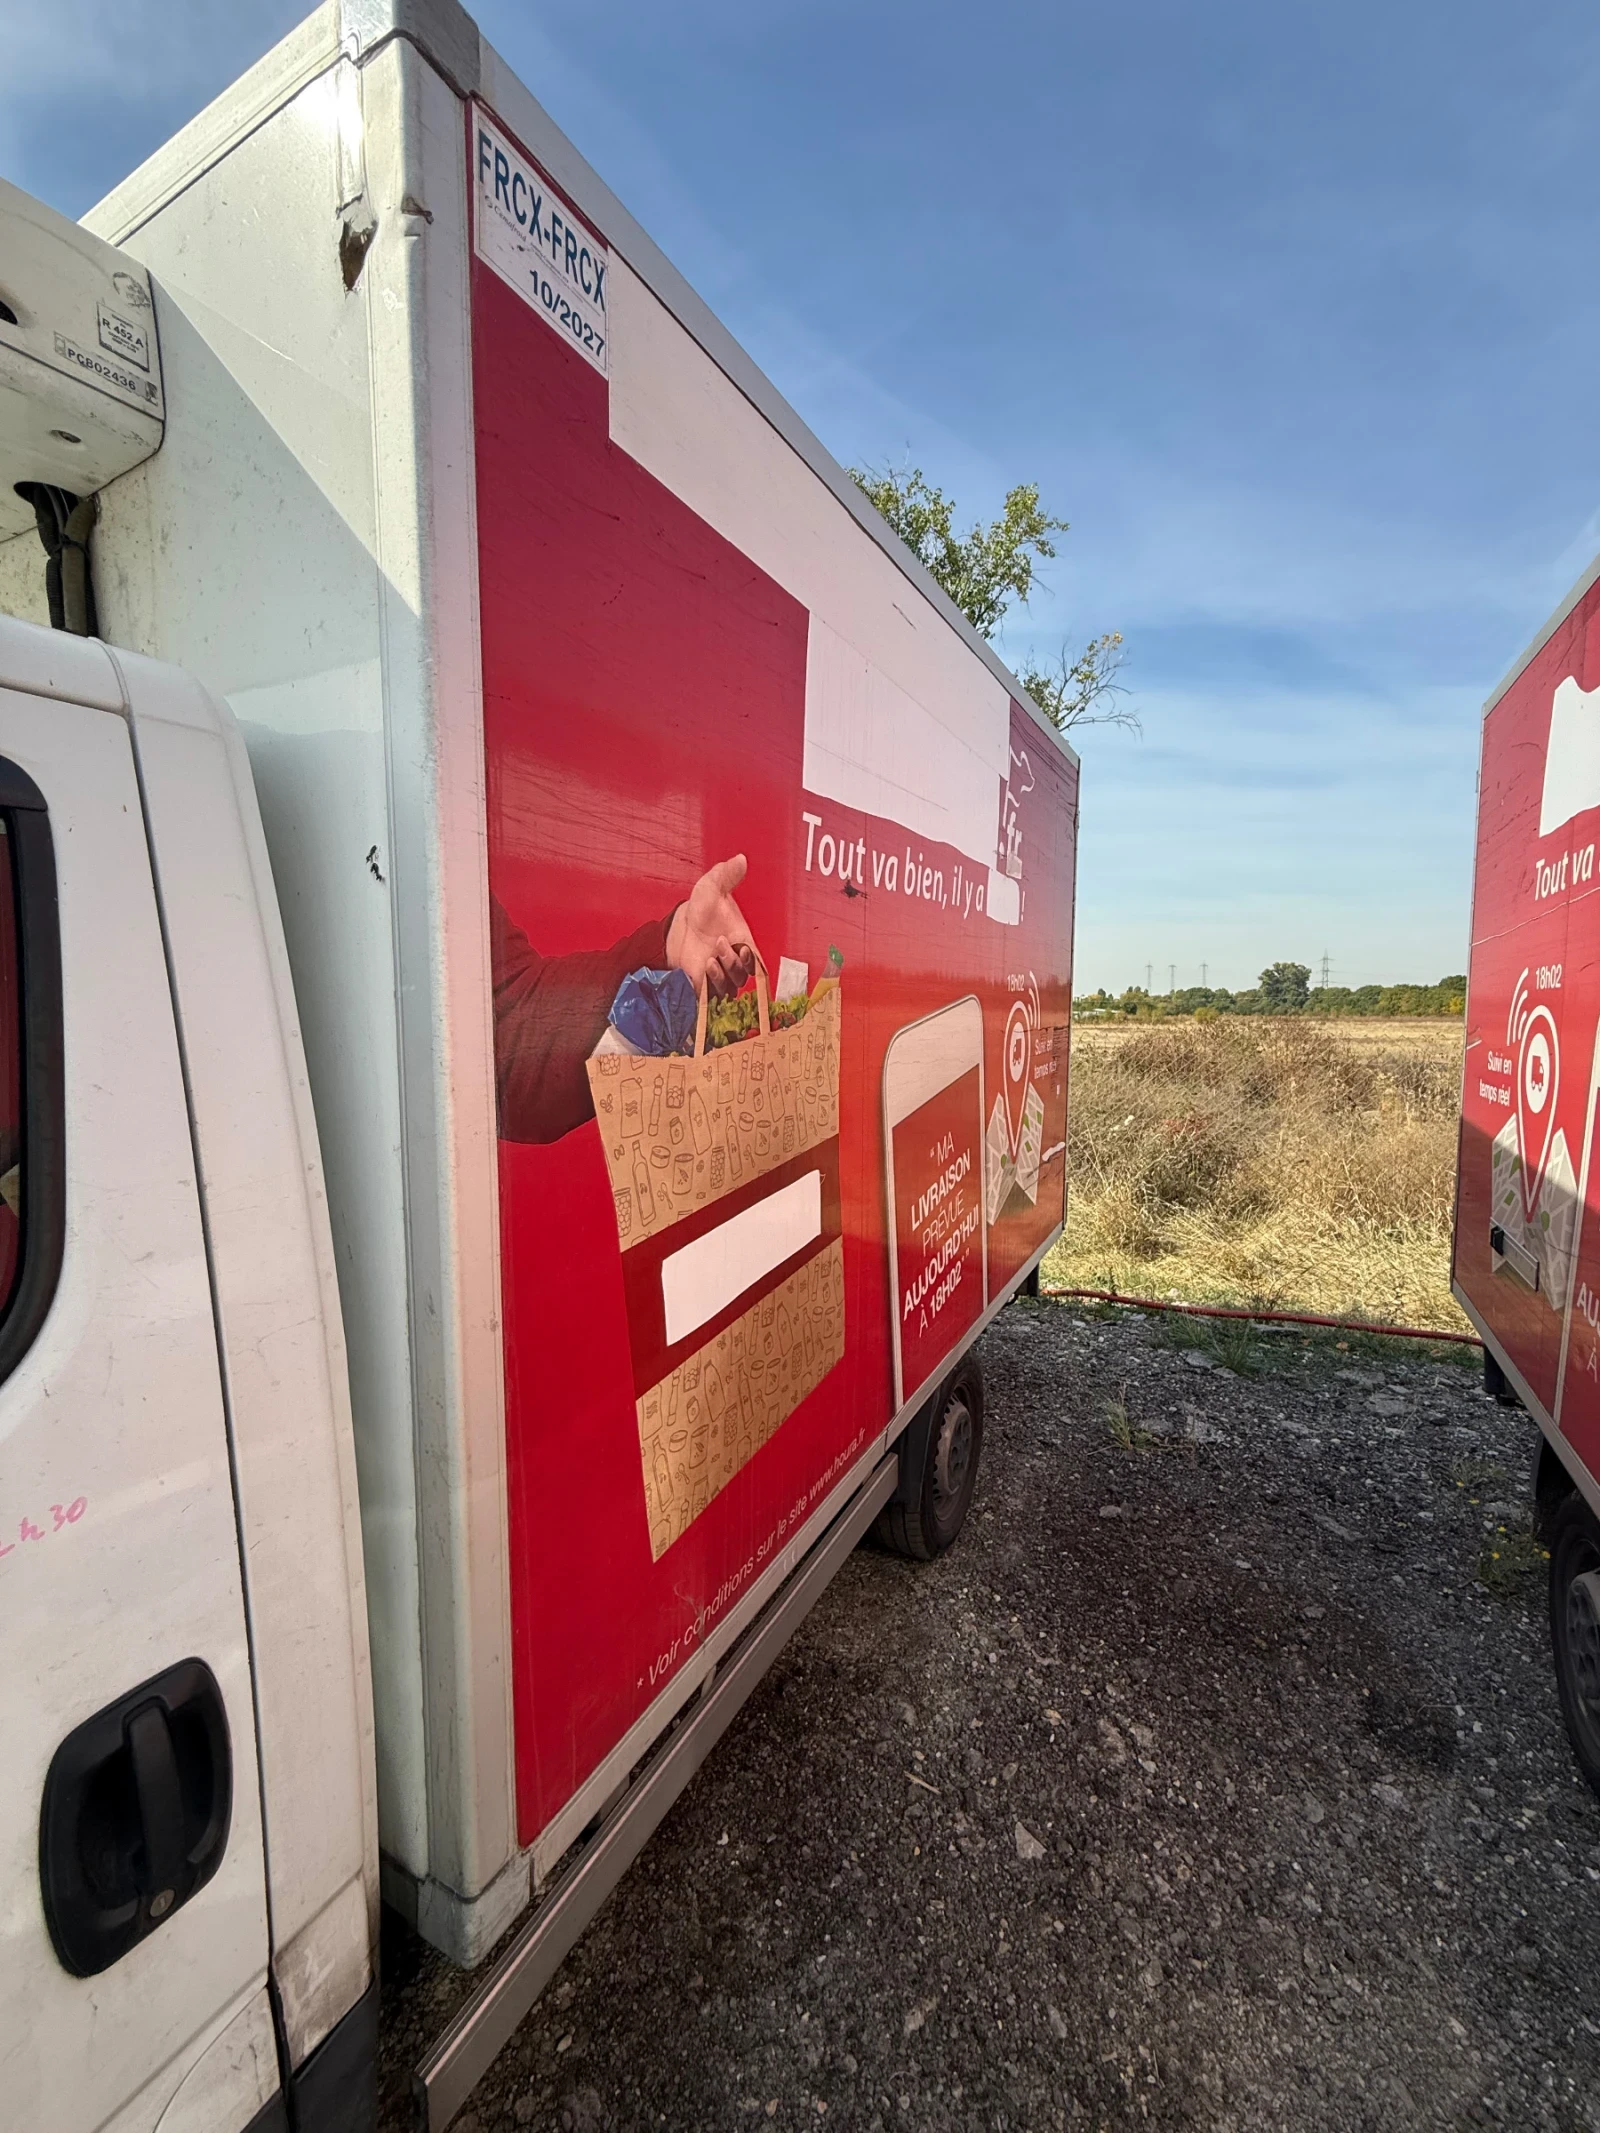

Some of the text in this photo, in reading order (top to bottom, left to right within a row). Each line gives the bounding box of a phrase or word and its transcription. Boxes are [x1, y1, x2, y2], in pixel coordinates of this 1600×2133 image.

[478, 129, 606, 313] FRCX-FRCX
[102, 317, 111, 330] R
[114, 326, 133, 342] 452
[136, 337, 144, 348] A
[530, 269, 606, 357] 10/2027
[67, 348, 136, 391] PCB02436
[802, 811, 985, 920] Tout va bien, il y a
[1535, 844, 1595, 901] Tout va
[1536, 963, 1562, 990] 18h02
[1488, 1050, 1512, 1075] Suivi en
[1479, 1079, 1497, 1104] temps
[937, 1131, 955, 1167] MA
[911, 1147, 971, 1231] LIVRAISON
[922, 1188, 965, 1257] PRÉVUE
[903, 1204, 979, 1321] AUJOURD'HUI
[919, 1304, 928, 1338] À
[1577, 1282, 1600, 1337] AU
[649, 1636, 681, 1686] Voir
[684, 1555, 754, 1647] conditions
[756, 1532, 776, 1562] sur
[777, 1519, 787, 1540] le
[789, 1495, 807, 1525] site
[809, 1427, 866, 1502] www.houra.fr
